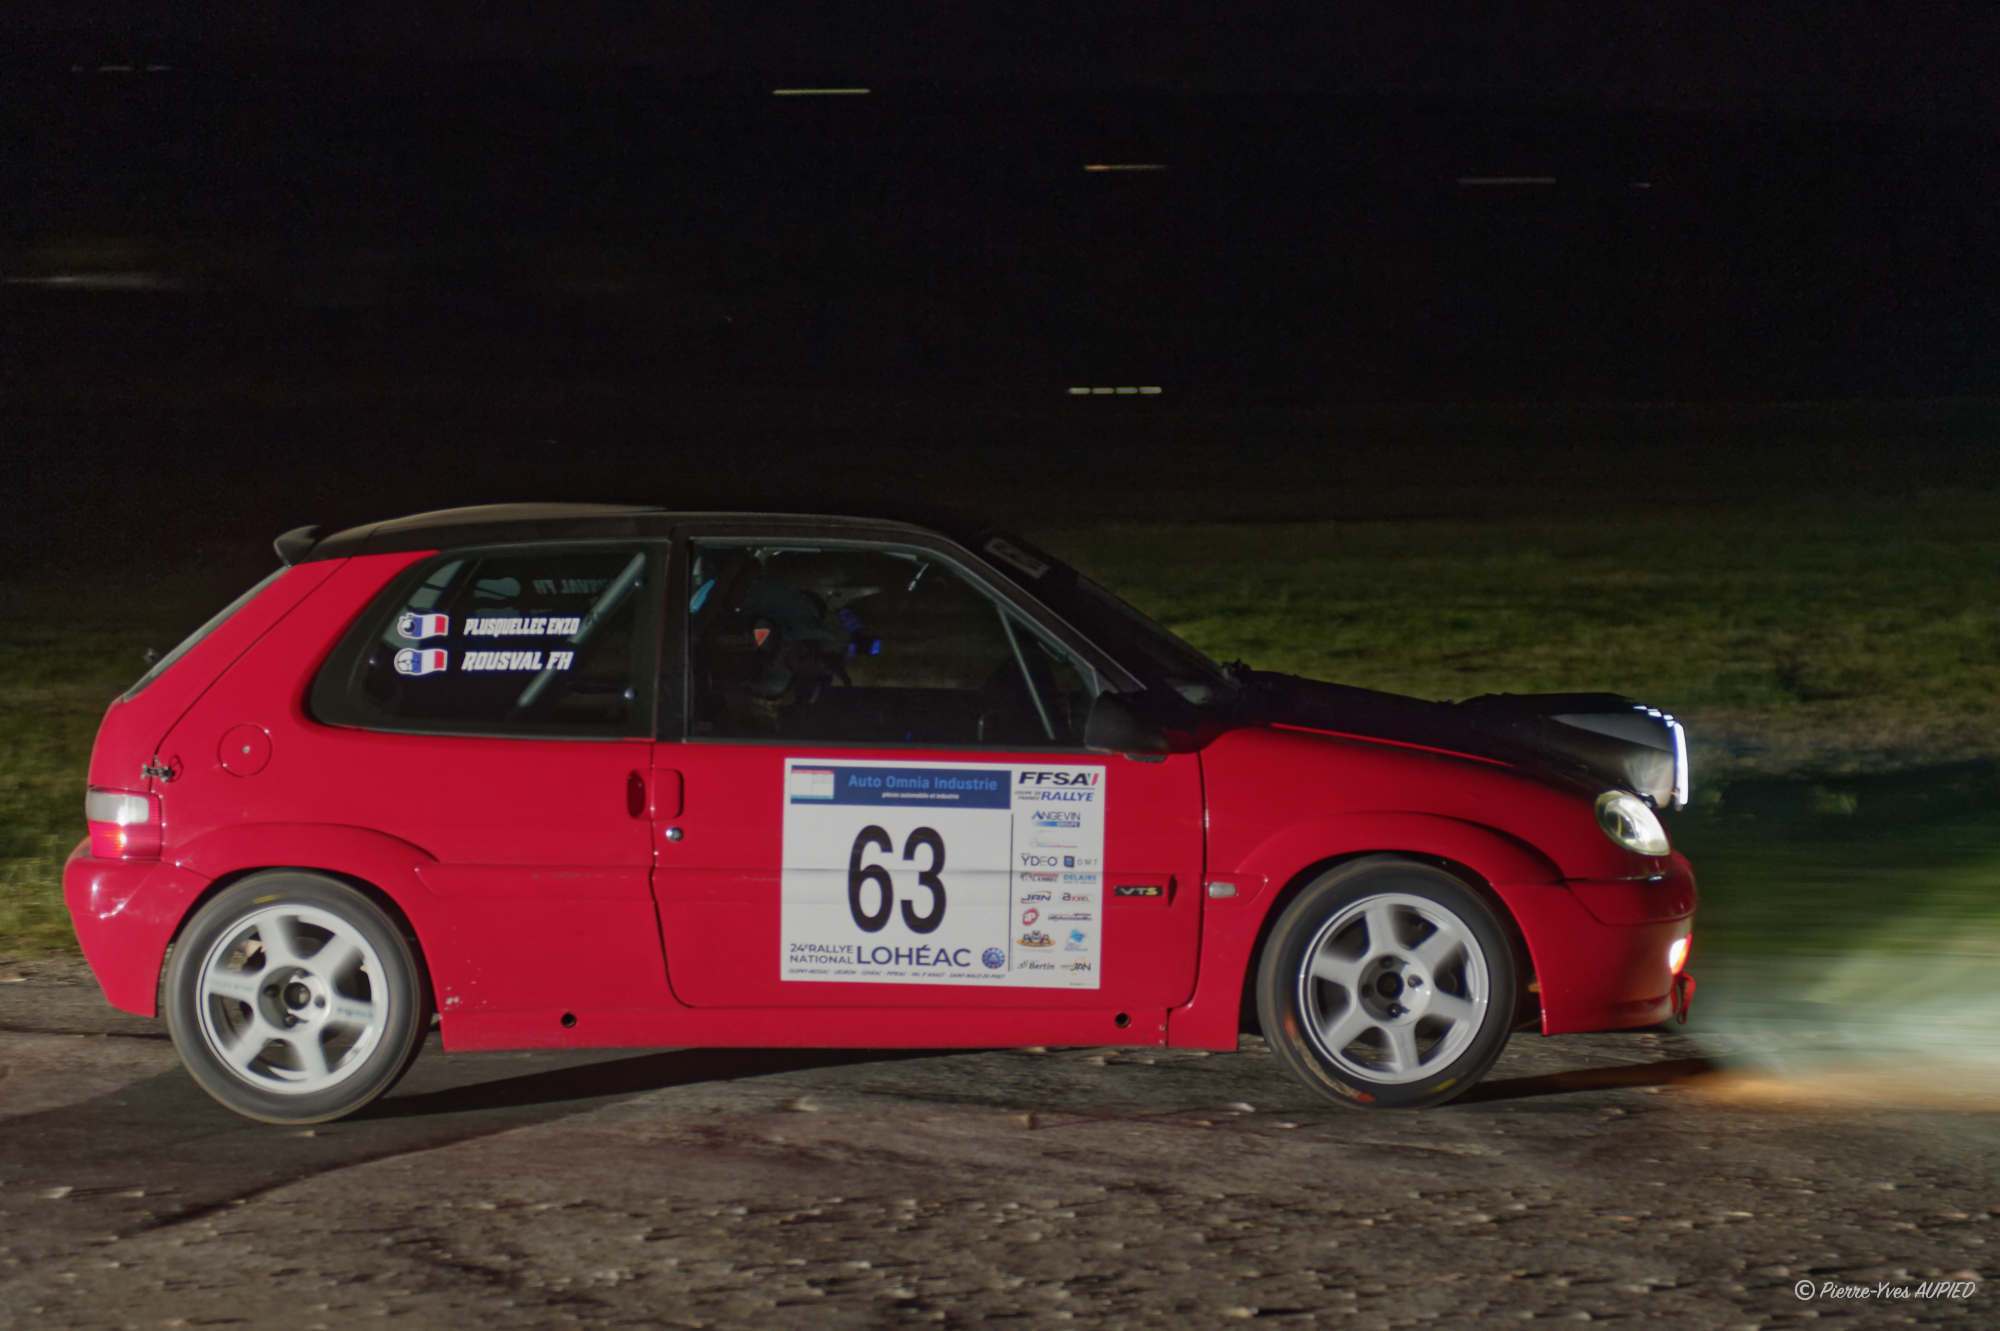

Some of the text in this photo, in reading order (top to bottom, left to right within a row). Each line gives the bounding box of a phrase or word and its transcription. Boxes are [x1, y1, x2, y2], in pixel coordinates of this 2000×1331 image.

[463, 618, 546, 637] PLUSQUELLEC
[461, 651, 543, 671] ROUSVAL
[848, 774, 998, 791] Auto Omnia Industrie
[1019, 771, 1089, 786] FFSA
[1041, 791, 1095, 802] RALLYE
[1032, 810, 1081, 820] ANGEVIN
[847, 824, 947, 935] 63
[1120, 887, 1159, 896] VTS
[808, 943, 854, 955] RALLYE
[856, 944, 972, 968] LOHÉAC
[789, 954, 854, 965] NATIONAL
